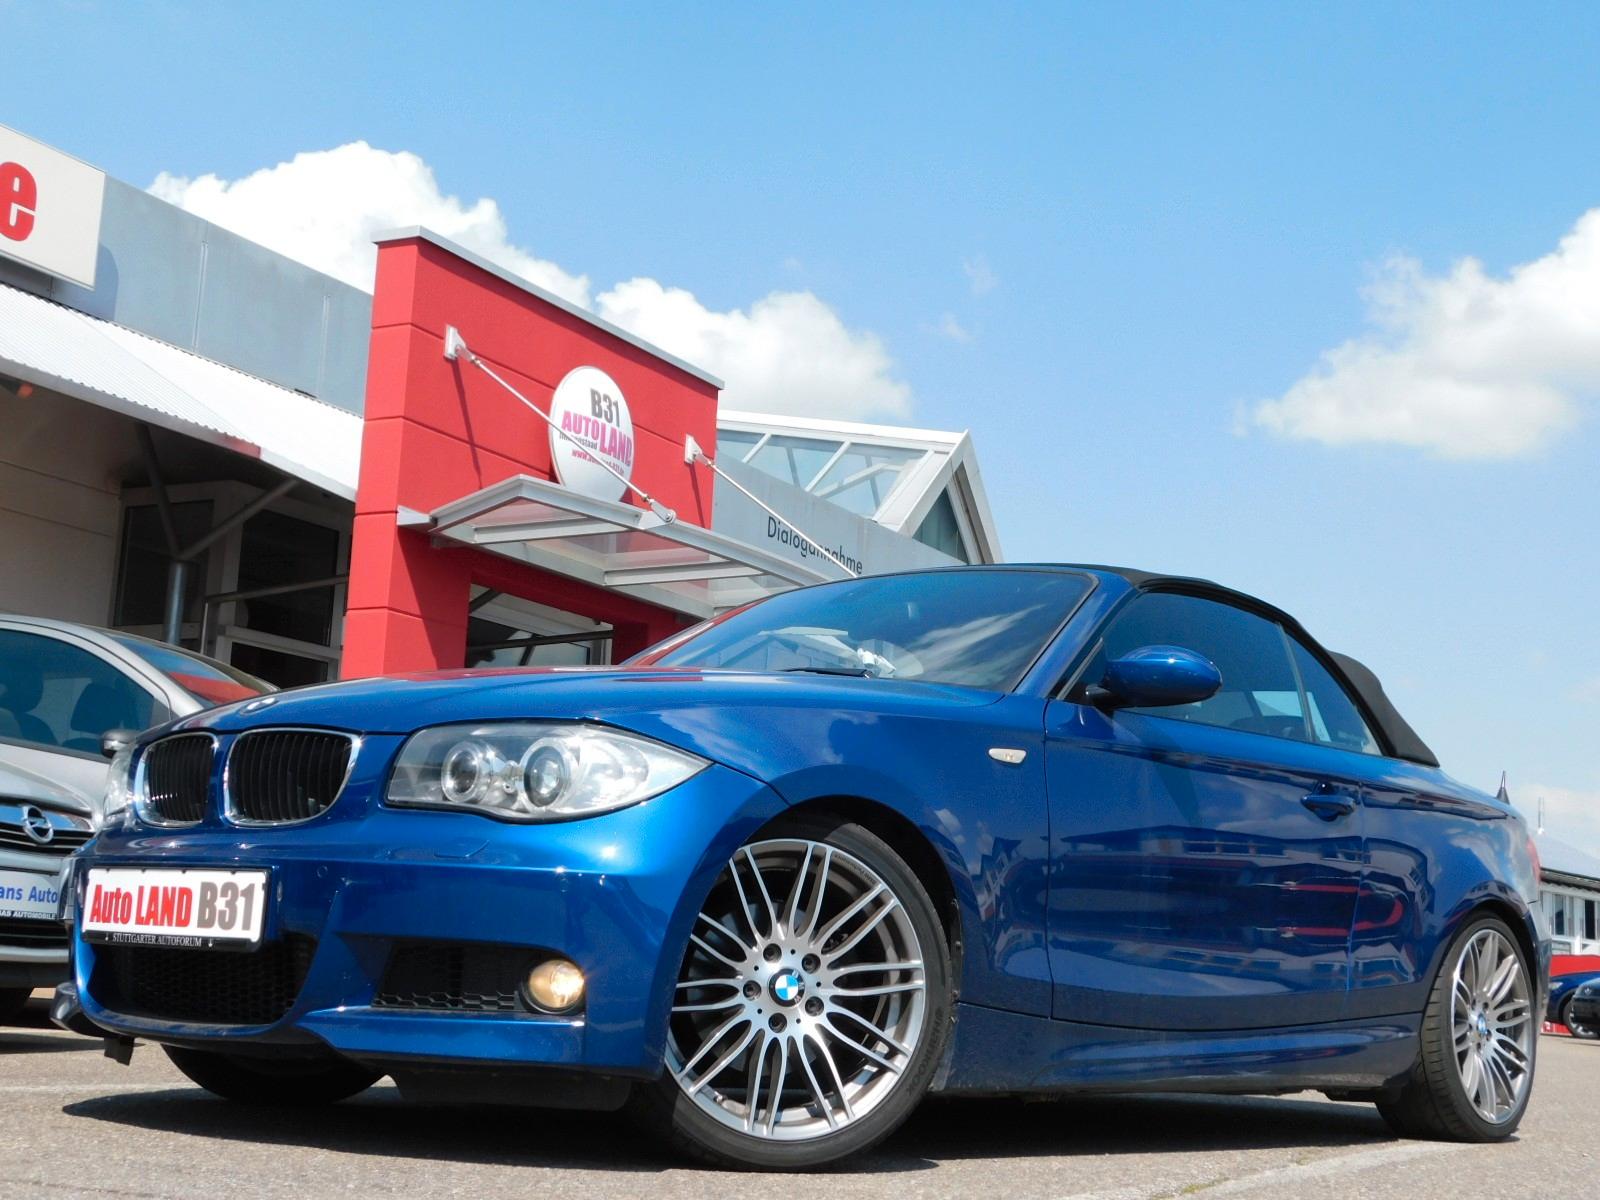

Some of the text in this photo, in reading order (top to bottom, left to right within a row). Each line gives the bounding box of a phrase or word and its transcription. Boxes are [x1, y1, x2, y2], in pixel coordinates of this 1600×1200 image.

[0, 161, 38, 242] e
[590, 388, 620, 427] B31
[28, 886, 58, 903] Auto
[89, 881, 256, 931] Auto LAND B31
[112, 932, 202, 947] STUTTGARTER AUTOFORUM
